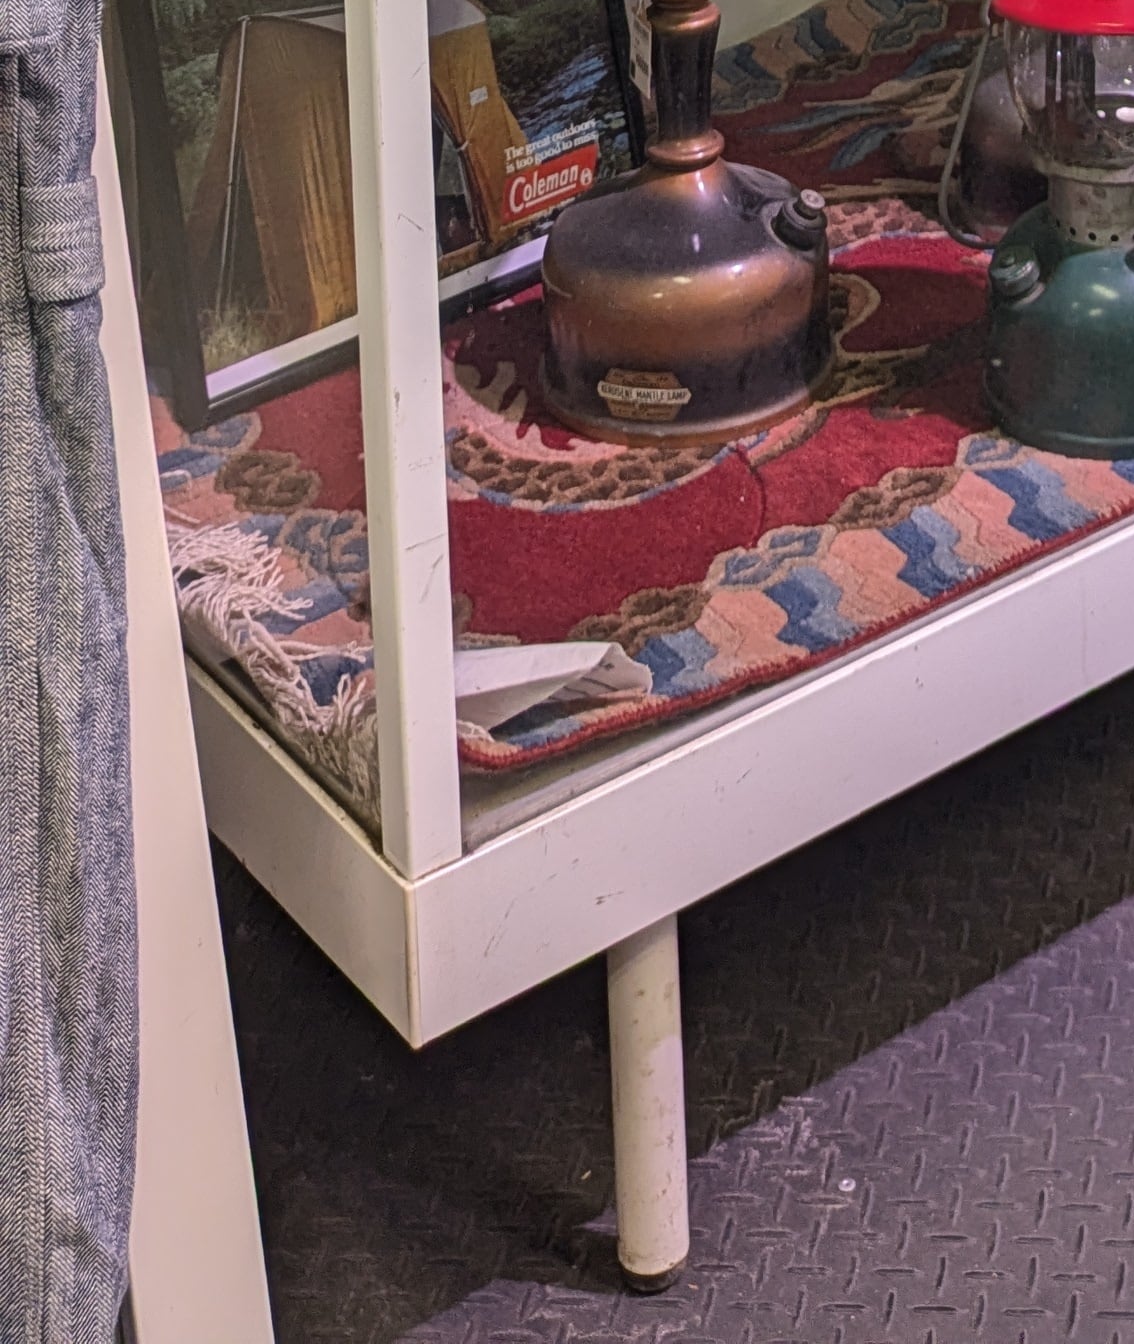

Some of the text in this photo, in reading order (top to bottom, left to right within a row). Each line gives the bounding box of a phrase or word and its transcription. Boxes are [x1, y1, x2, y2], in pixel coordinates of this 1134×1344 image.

[504, 118, 596, 161] The great outdoors
[506, 163, 515, 174] is
[516, 156, 534, 170] too
[534, 142, 562, 164] good
[562, 138, 572, 148] to
[509, 164, 579, 214] Coleman
[636, 389, 664, 401] MANTLE
[668, 390, 688, 402] LAMP
